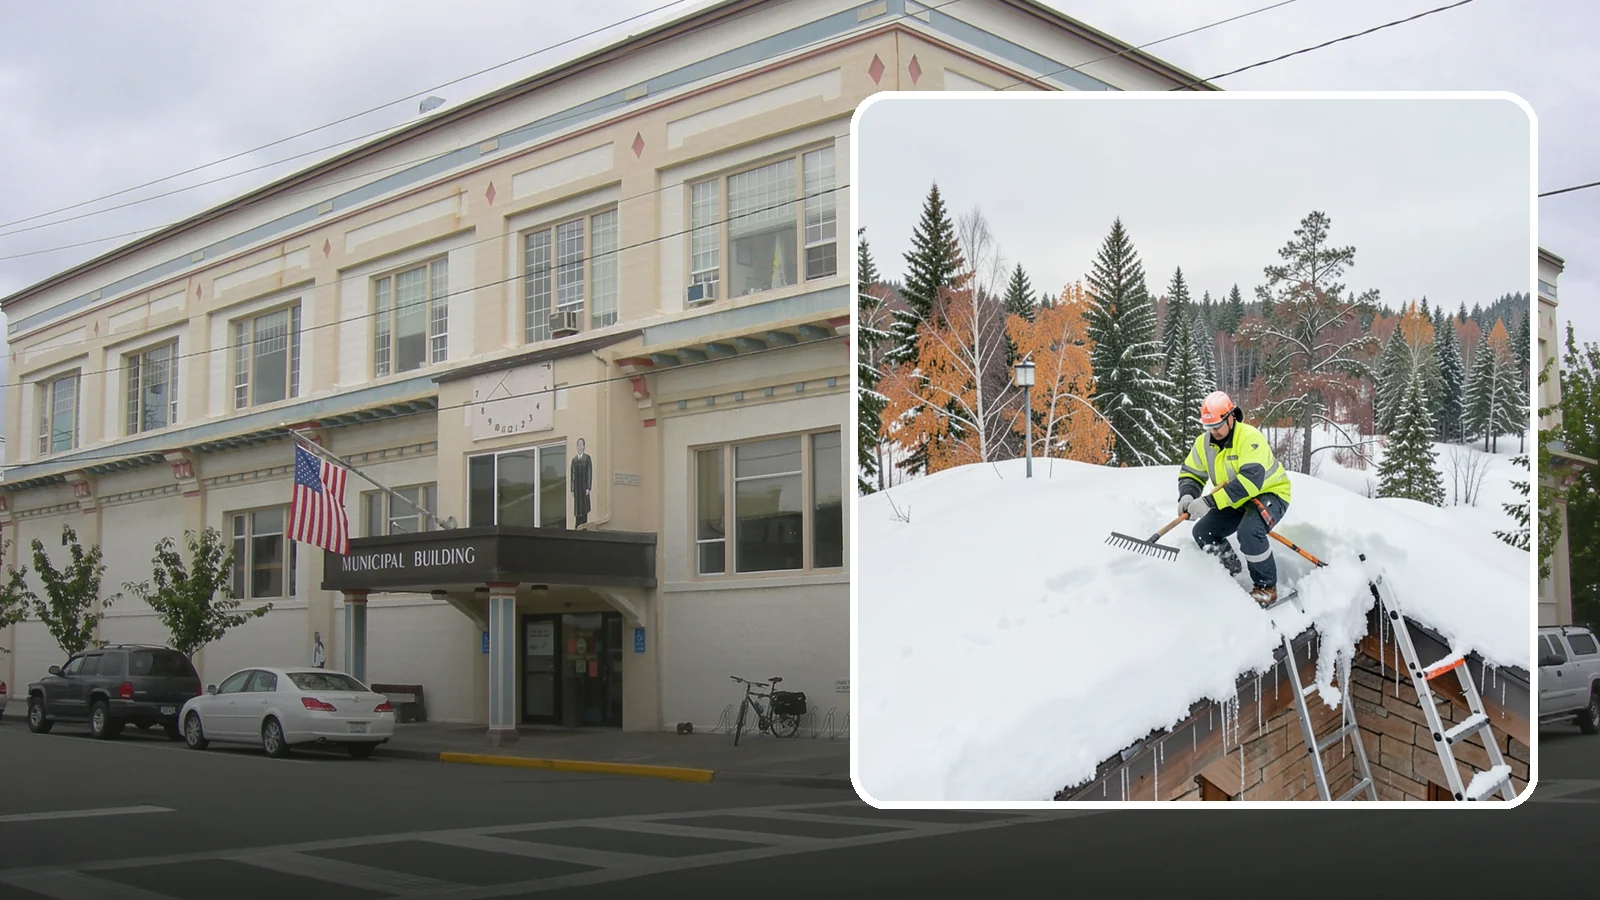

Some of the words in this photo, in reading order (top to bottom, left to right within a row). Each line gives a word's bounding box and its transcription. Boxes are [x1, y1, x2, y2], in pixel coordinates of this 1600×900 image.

[481, 407, 484, 415] 8
[495, 423, 500, 431] 10
[508, 425, 513, 433] 12
[521, 420, 525, 428] 2
[536, 402, 540, 410] 4
[342, 553, 405, 571] MUNICIPAL
[414, 547, 475, 567] BUILDING
